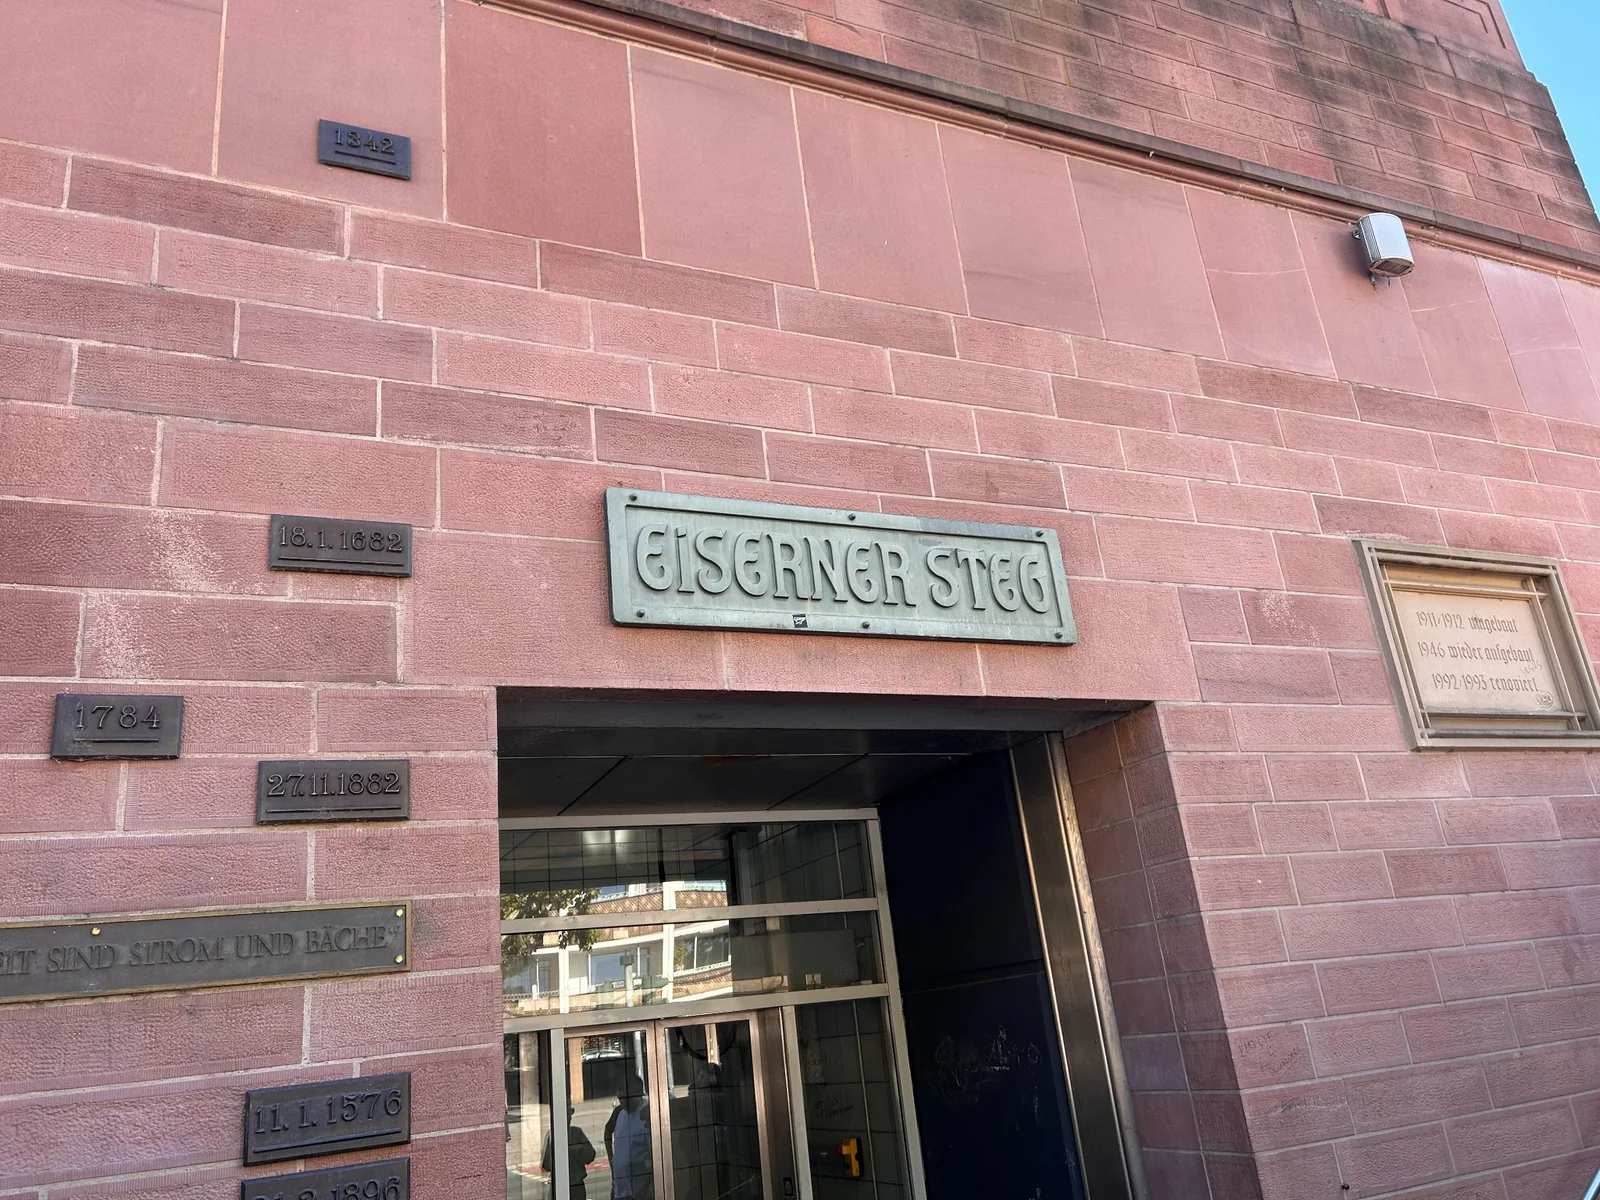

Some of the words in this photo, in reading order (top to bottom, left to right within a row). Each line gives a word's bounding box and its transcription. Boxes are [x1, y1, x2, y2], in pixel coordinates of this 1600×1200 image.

[926, 546, 1051, 614] STEG
[1468, 615, 1519, 635] umgebaut
[1417, 641, 1446, 659] 1946
[1489, 675, 1539, 693] renoviert
[76, 704, 160, 729] 1784
[47, 944, 118, 973] SIND
[128, 936, 225, 967] STROM
[235, 932, 294, 960] UND
